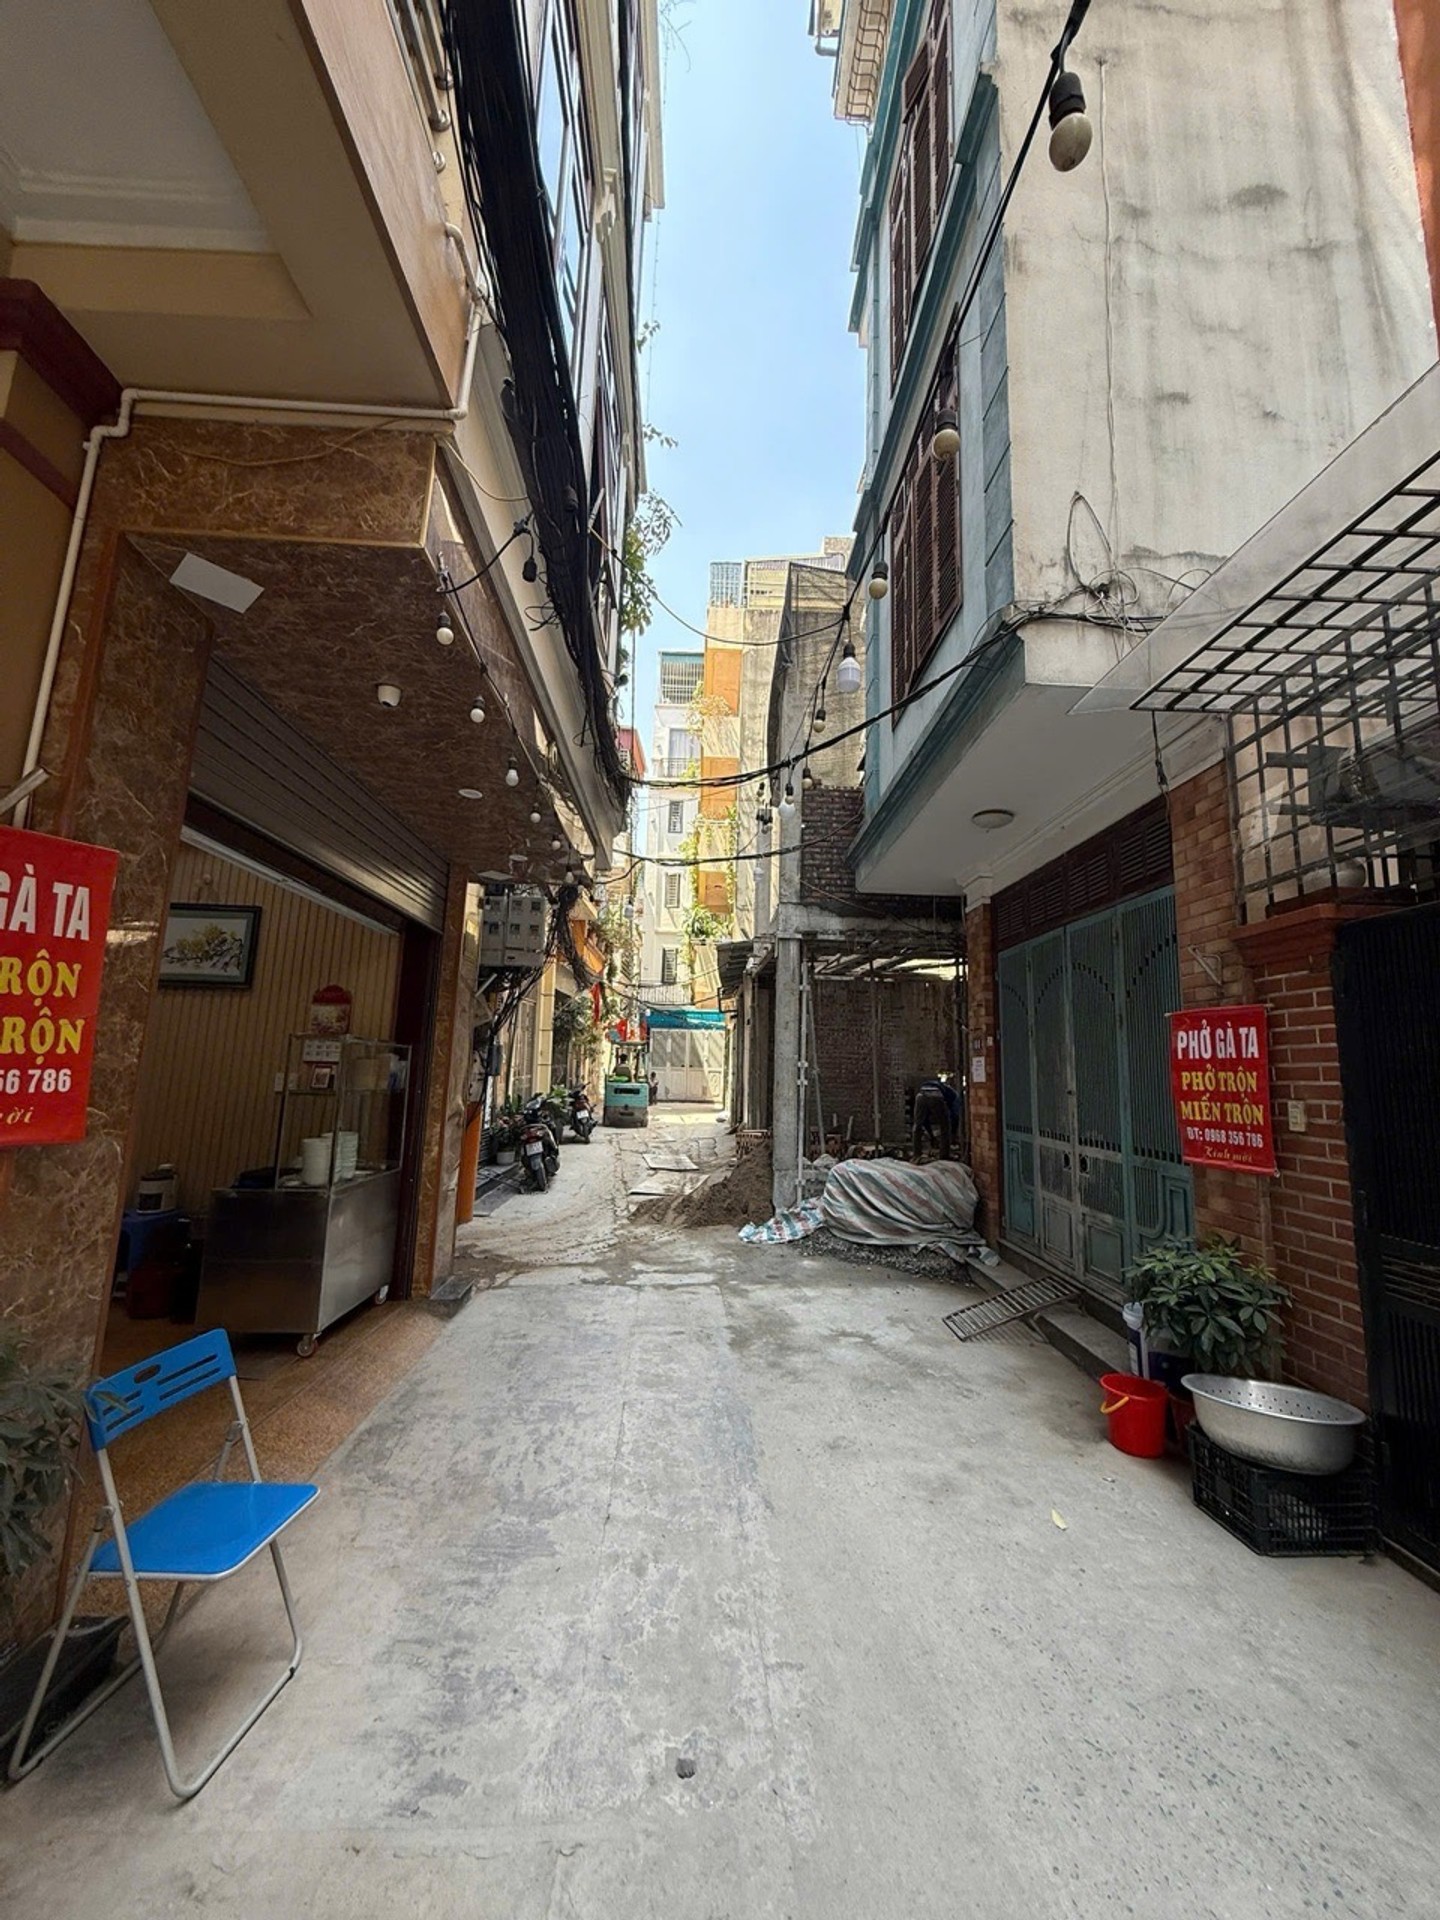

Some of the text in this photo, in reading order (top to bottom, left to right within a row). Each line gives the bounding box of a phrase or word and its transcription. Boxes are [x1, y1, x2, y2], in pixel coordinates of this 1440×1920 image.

[53, 881, 90, 941] TA
[1177, 1019, 1260, 1059] PHỞ GÀ TA
[28, 1068, 72, 1093] 786
[1181, 1063, 1257, 1098] PHỞ TRỘN
[1180, 1092, 1264, 1130] MIẾN TRỘN
[1204, 1127, 1227, 1144] 0968
[1228, 1130, 1245, 1146] 356
[1245, 1132, 1264, 1148] 786
